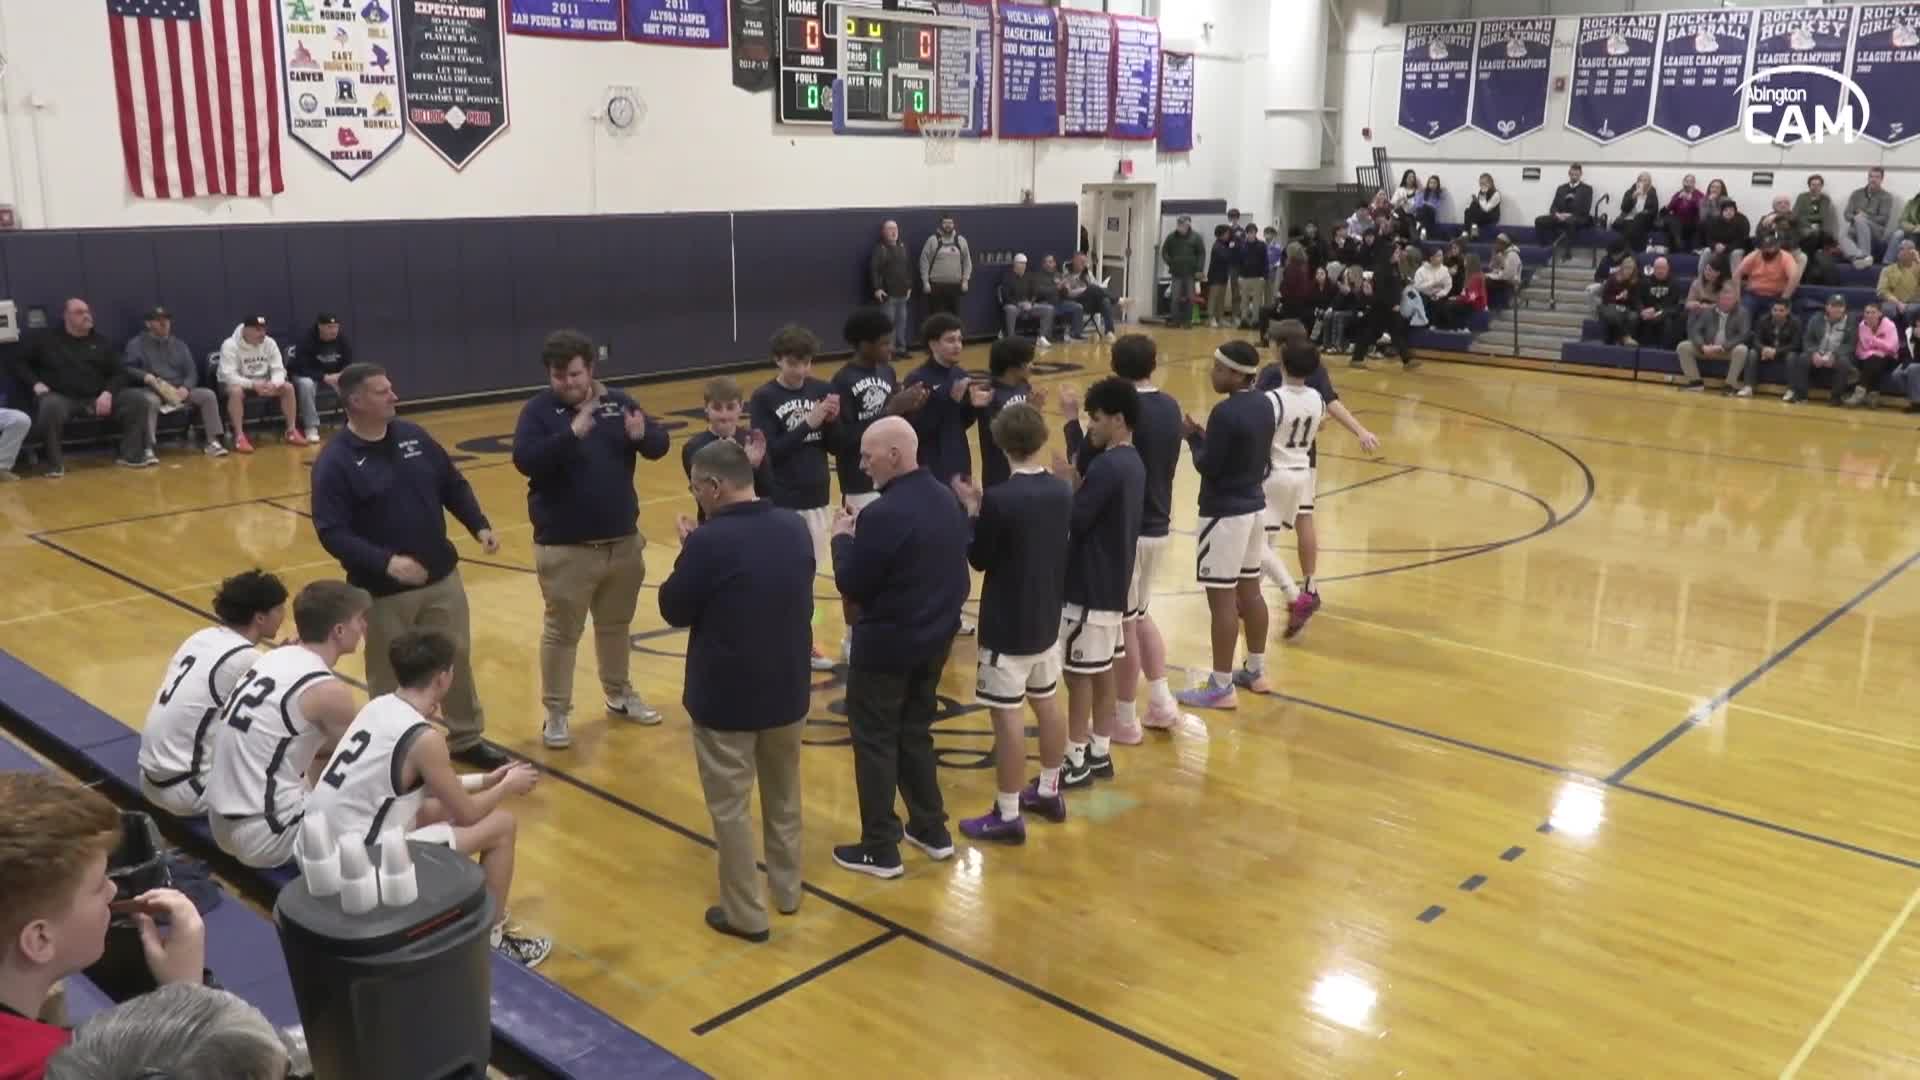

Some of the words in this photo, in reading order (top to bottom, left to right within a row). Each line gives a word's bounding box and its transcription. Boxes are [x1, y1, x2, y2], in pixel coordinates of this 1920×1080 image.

[414, 1, 486, 20] EXPECTATION!
[552, 2, 579, 15] 2011
[665, 0, 689, 11] 2011
[788, 0, 818, 15] HOME
[680, 12, 706, 25] JASPER
[1007, 10, 1050, 26] ROCKLAND
[1669, 12, 1749, 27] ROCKLAND
[1763, 8, 1849, 24] ROCKLAND
[1863, 6, 1920, 20] ROCKL
[587, 20, 617, 32] METERS
[1483, 20, 1552, 33] ROCKLAND
[1582, 16, 1656, 30] ROCKLAND
[424, 32, 457, 41] PLAYERS
[434, 25, 448, 33] LET
[451, 27, 465, 35] THE
[806, 20, 819, 49] 0
[1004, 25, 1053, 42] BASKETBALL
[1408, 24, 1472, 38] ROCKLAND
[1580, 28, 1655, 44] CHEERLEADING
[1666, 25, 1746, 42] BASEBALL
[1760, 21, 1846, 42] HOCKEY
[920, 31, 931, 58] 0
[1514, 31, 1551, 47] TENNIS
[420, 52, 455, 61] COACHES
[437, 45, 451, 53] LET
[453, 47, 467, 55] THE
[1020, 44, 1036, 57] POINT
[1856, 51, 1892, 63] LEAGUE
[1894, 50, 1920, 61] CHAM
[801, 55, 825, 67] BONUS
[846, 51, 868, 63] ERIOD
[1577, 57, 1606, 68] LEAGUE
[1608, 56, 1651, 67] CHAMPIONS
[1663, 55, 1694, 67] LEAGUE
[1695, 54, 1742, 66] CHAMPIONS
[1757, 53, 1789, 65] LEAGUE
[1791, 52, 1842, 64] CHAMPIONS
[437, 66, 451, 74] LET
[453, 67, 467, 75] THE
[1405, 61, 1430, 72] LEAGUE
[1431, 60, 1469, 72] CHAMPIONS
[1479, 60, 1505, 70] LEAGUE
[1507, 58, 1547, 69] CHAMPIONS
[290, 71, 323, 82] CARVER
[412, 72, 453, 81] OFFICIALS
[795, 73, 818, 84] FOULS
[868, 77, 882, 88] FOU
[438, 87, 452, 95] LET
[903, 80, 924, 90] FOULS
[808, 86, 819, 108] 0
[914, 91, 924, 113] 0
[325, 107, 367, 118] RANDOLPH
[363, 119, 399, 129] NORWELL
[330, 150, 373, 161] ROCKLAND
[852, 377, 892, 397] ROCKLAND
[775, 399, 817, 419] ROCKLAN
[1286, 415, 1312, 448] 11
[158, 655, 197, 705] 3
[323, 729, 372, 790] 2
